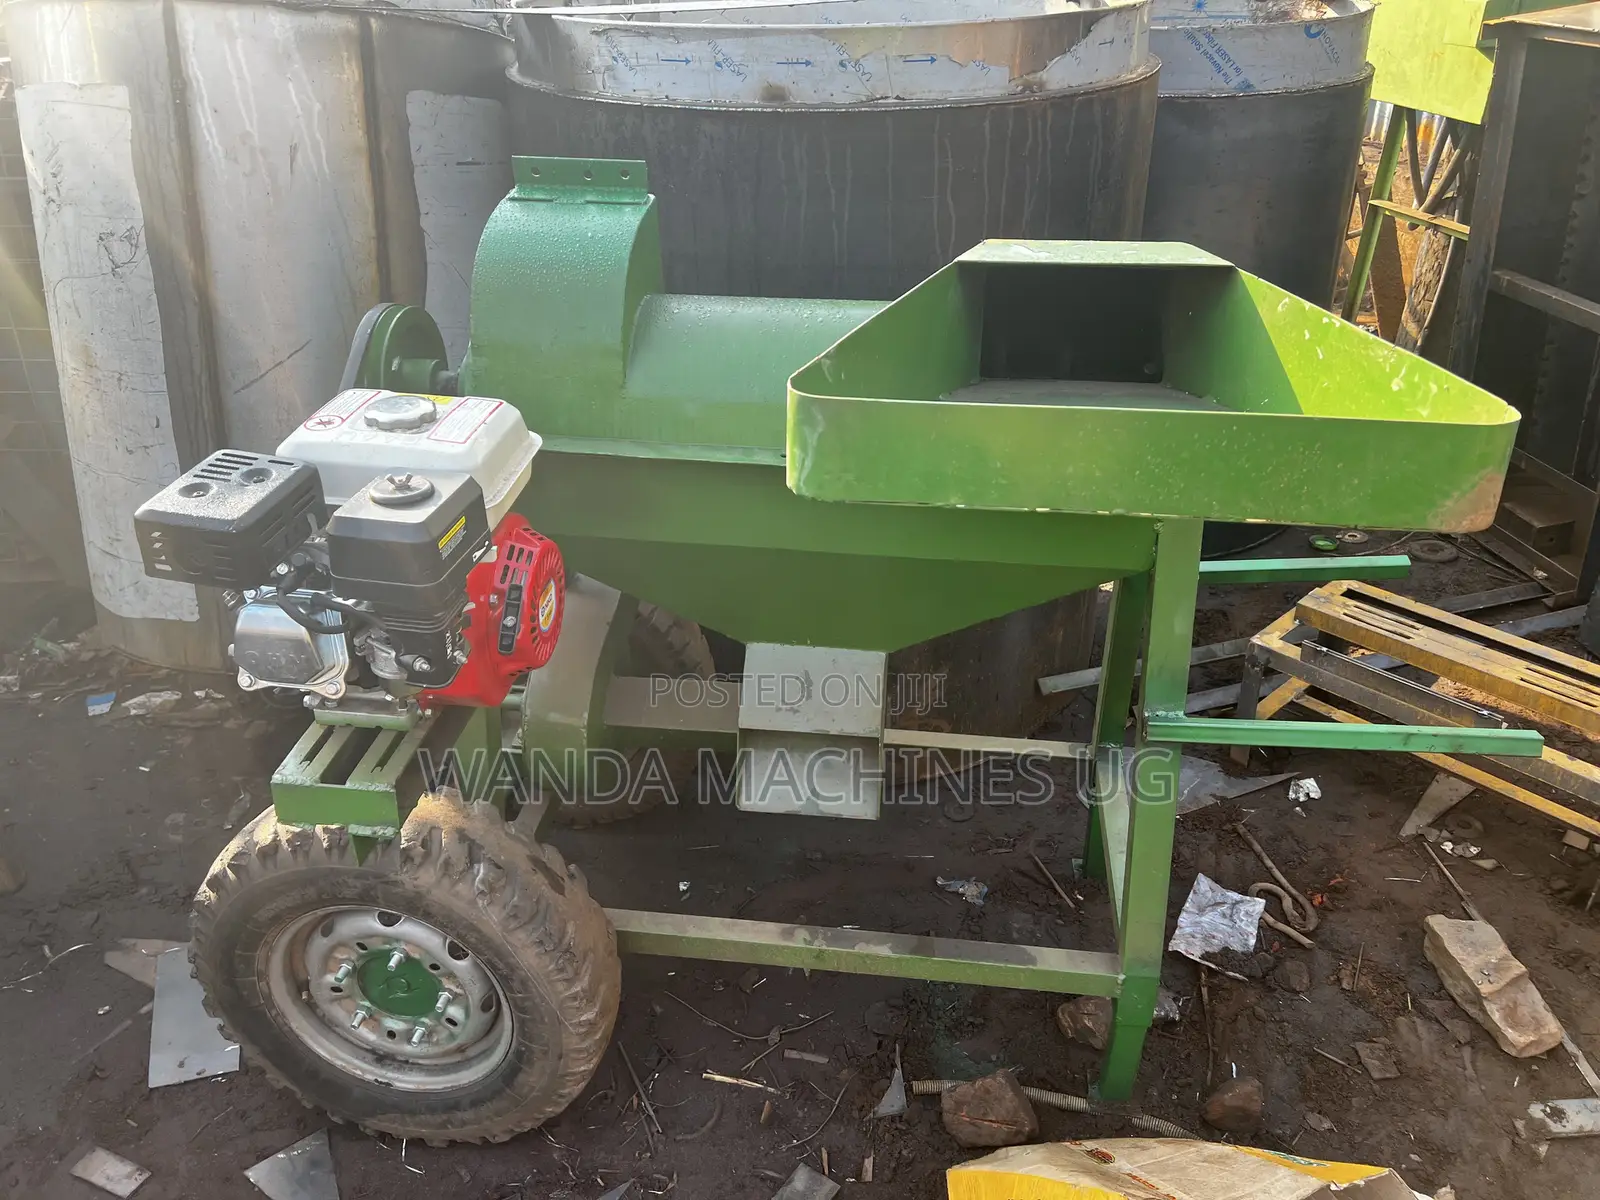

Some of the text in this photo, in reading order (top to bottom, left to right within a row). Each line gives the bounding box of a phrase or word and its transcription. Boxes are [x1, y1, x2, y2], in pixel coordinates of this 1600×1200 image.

[1200, 49, 1224, 74] Novacel
[1214, 45, 1236, 68] LASER
[1222, 71, 1233, 85] The
[1234, 65, 1243, 77] for
